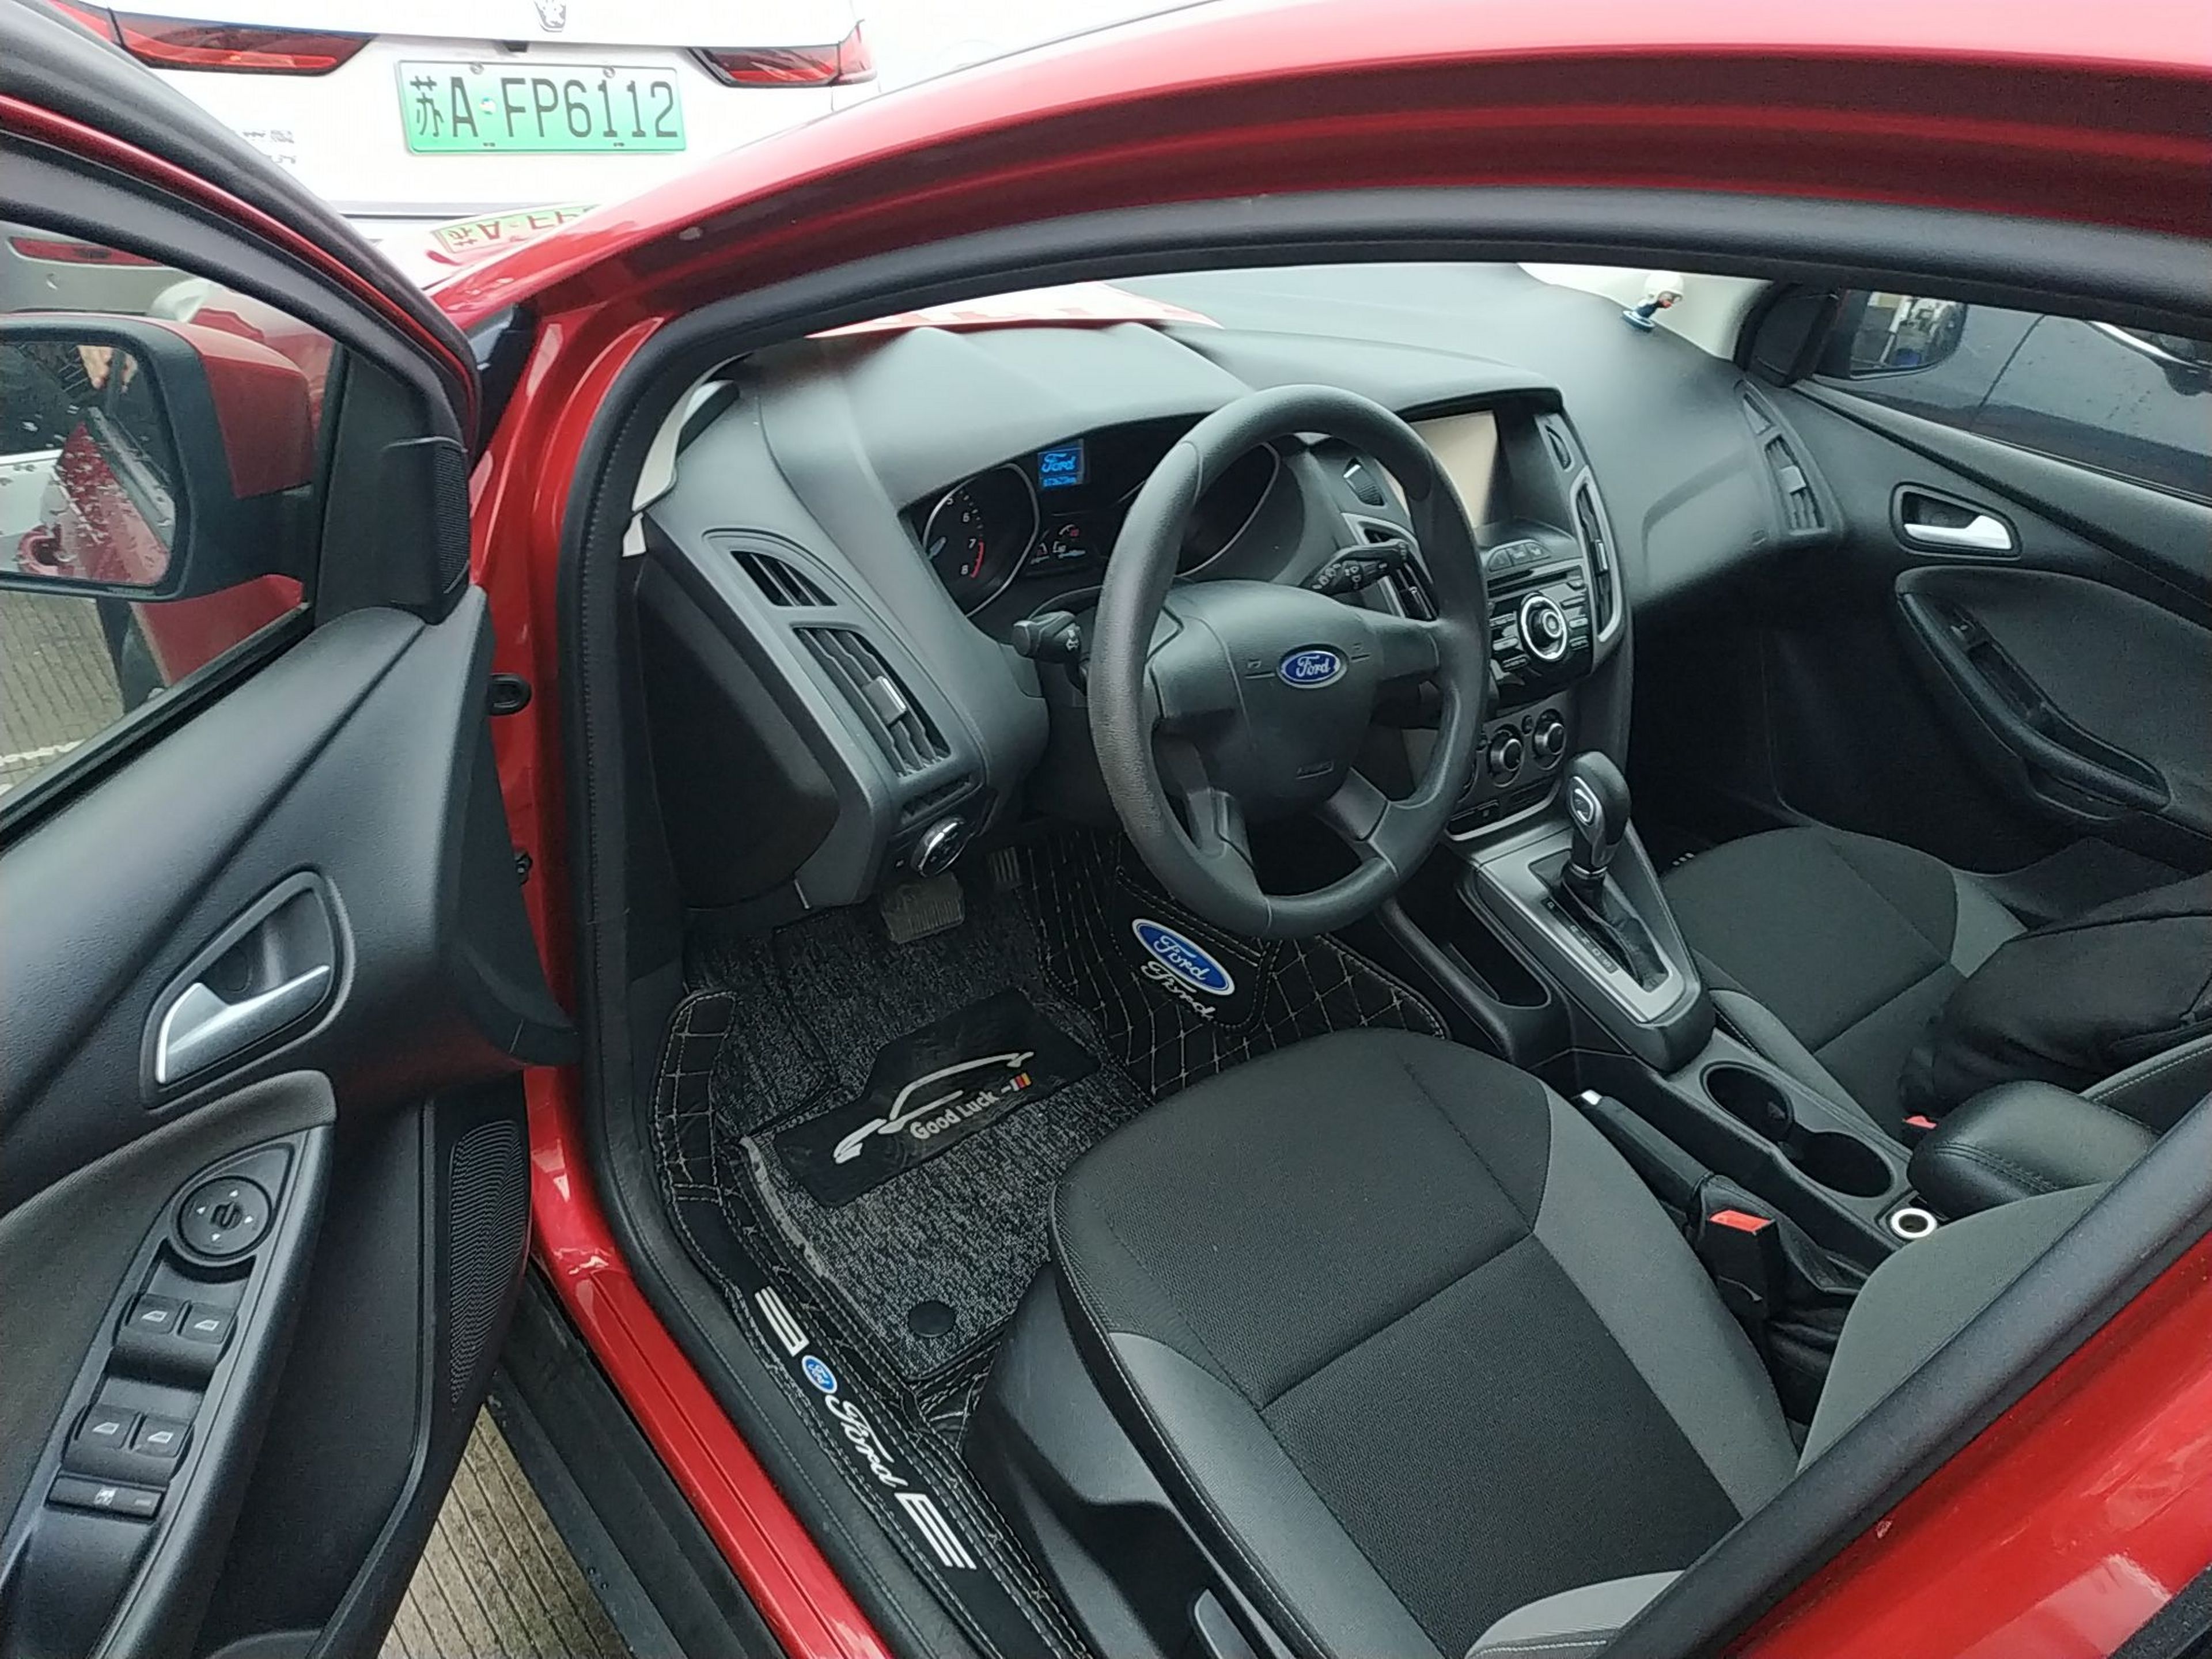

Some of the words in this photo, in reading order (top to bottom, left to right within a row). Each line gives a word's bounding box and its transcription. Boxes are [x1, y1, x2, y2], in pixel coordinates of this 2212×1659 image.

[1041, 453, 1076, 472] Ford
[963, 512, 970, 522] 6
[968, 538, 976, 548] 7
[961, 564, 968, 575] 8
[1296, 655, 1331, 677] Ford
[1153, 934, 1210, 980] Ford
[1141, 961, 1216, 1020] Ford
[910, 1108, 961, 1139] Good
[955, 1090, 1000, 1118] Luck
[825, 1394, 909, 1488] Ford
